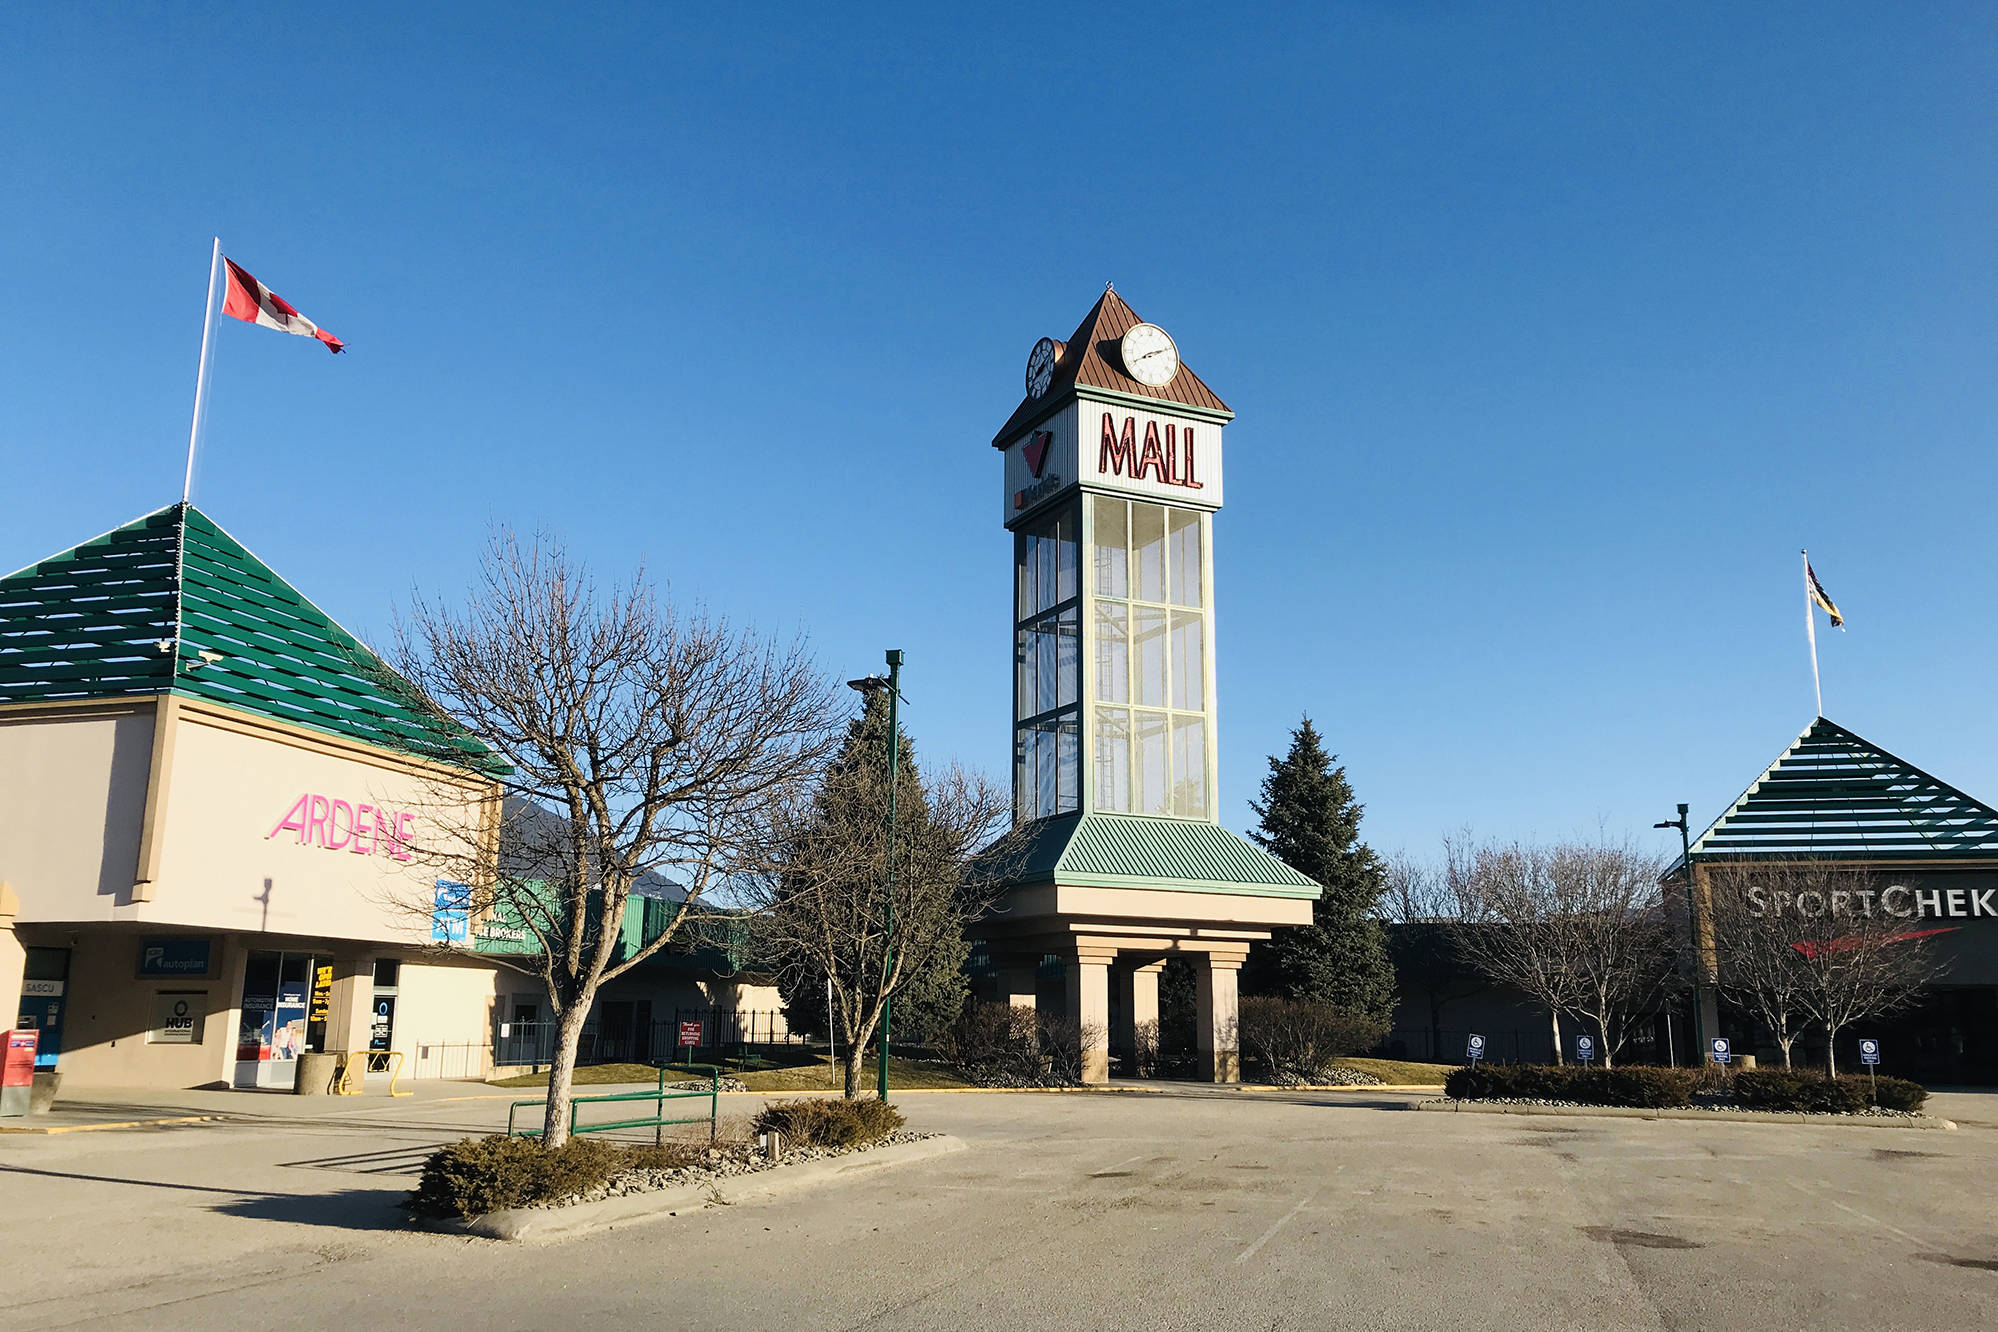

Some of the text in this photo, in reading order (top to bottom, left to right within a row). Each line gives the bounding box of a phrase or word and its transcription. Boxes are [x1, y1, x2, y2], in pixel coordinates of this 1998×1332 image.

[1099, 412, 1203, 489] MALL
[269, 793, 415, 860] ARDENE
[435, 915, 464, 935] ATM
[490, 927, 526, 940] BROKERS
[163, 959, 205, 970] autoplan
[26, 983, 54, 993] SASCU
[165, 1017, 193, 1029] HUB
